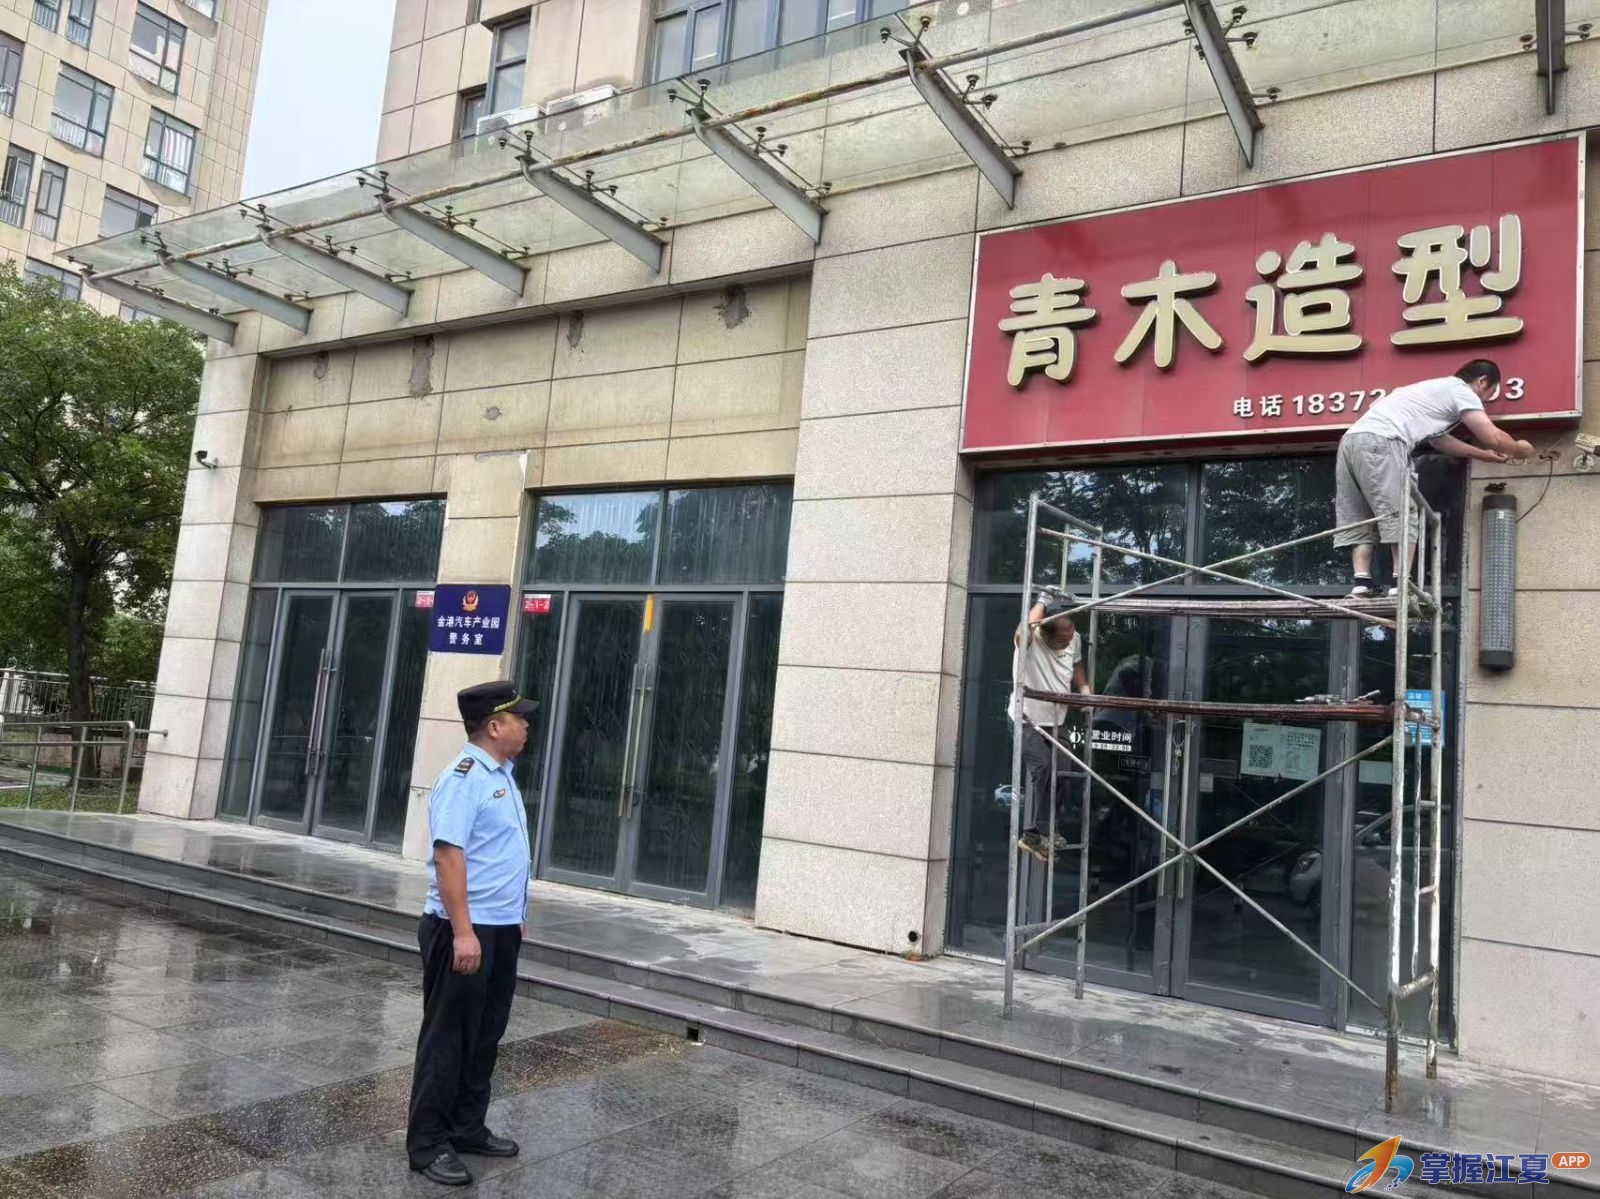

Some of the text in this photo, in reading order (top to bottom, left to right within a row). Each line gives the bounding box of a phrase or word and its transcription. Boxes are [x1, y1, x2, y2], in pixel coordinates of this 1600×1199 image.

[998, 213, 1525, 389] 青木造型
[1232, 394, 1283, 418] 电话
[436, 616, 501, 629] 金港汽车产业园
[449, 632, 484, 646] 警务室
[1091, 730, 1132, 743] 营业时间
